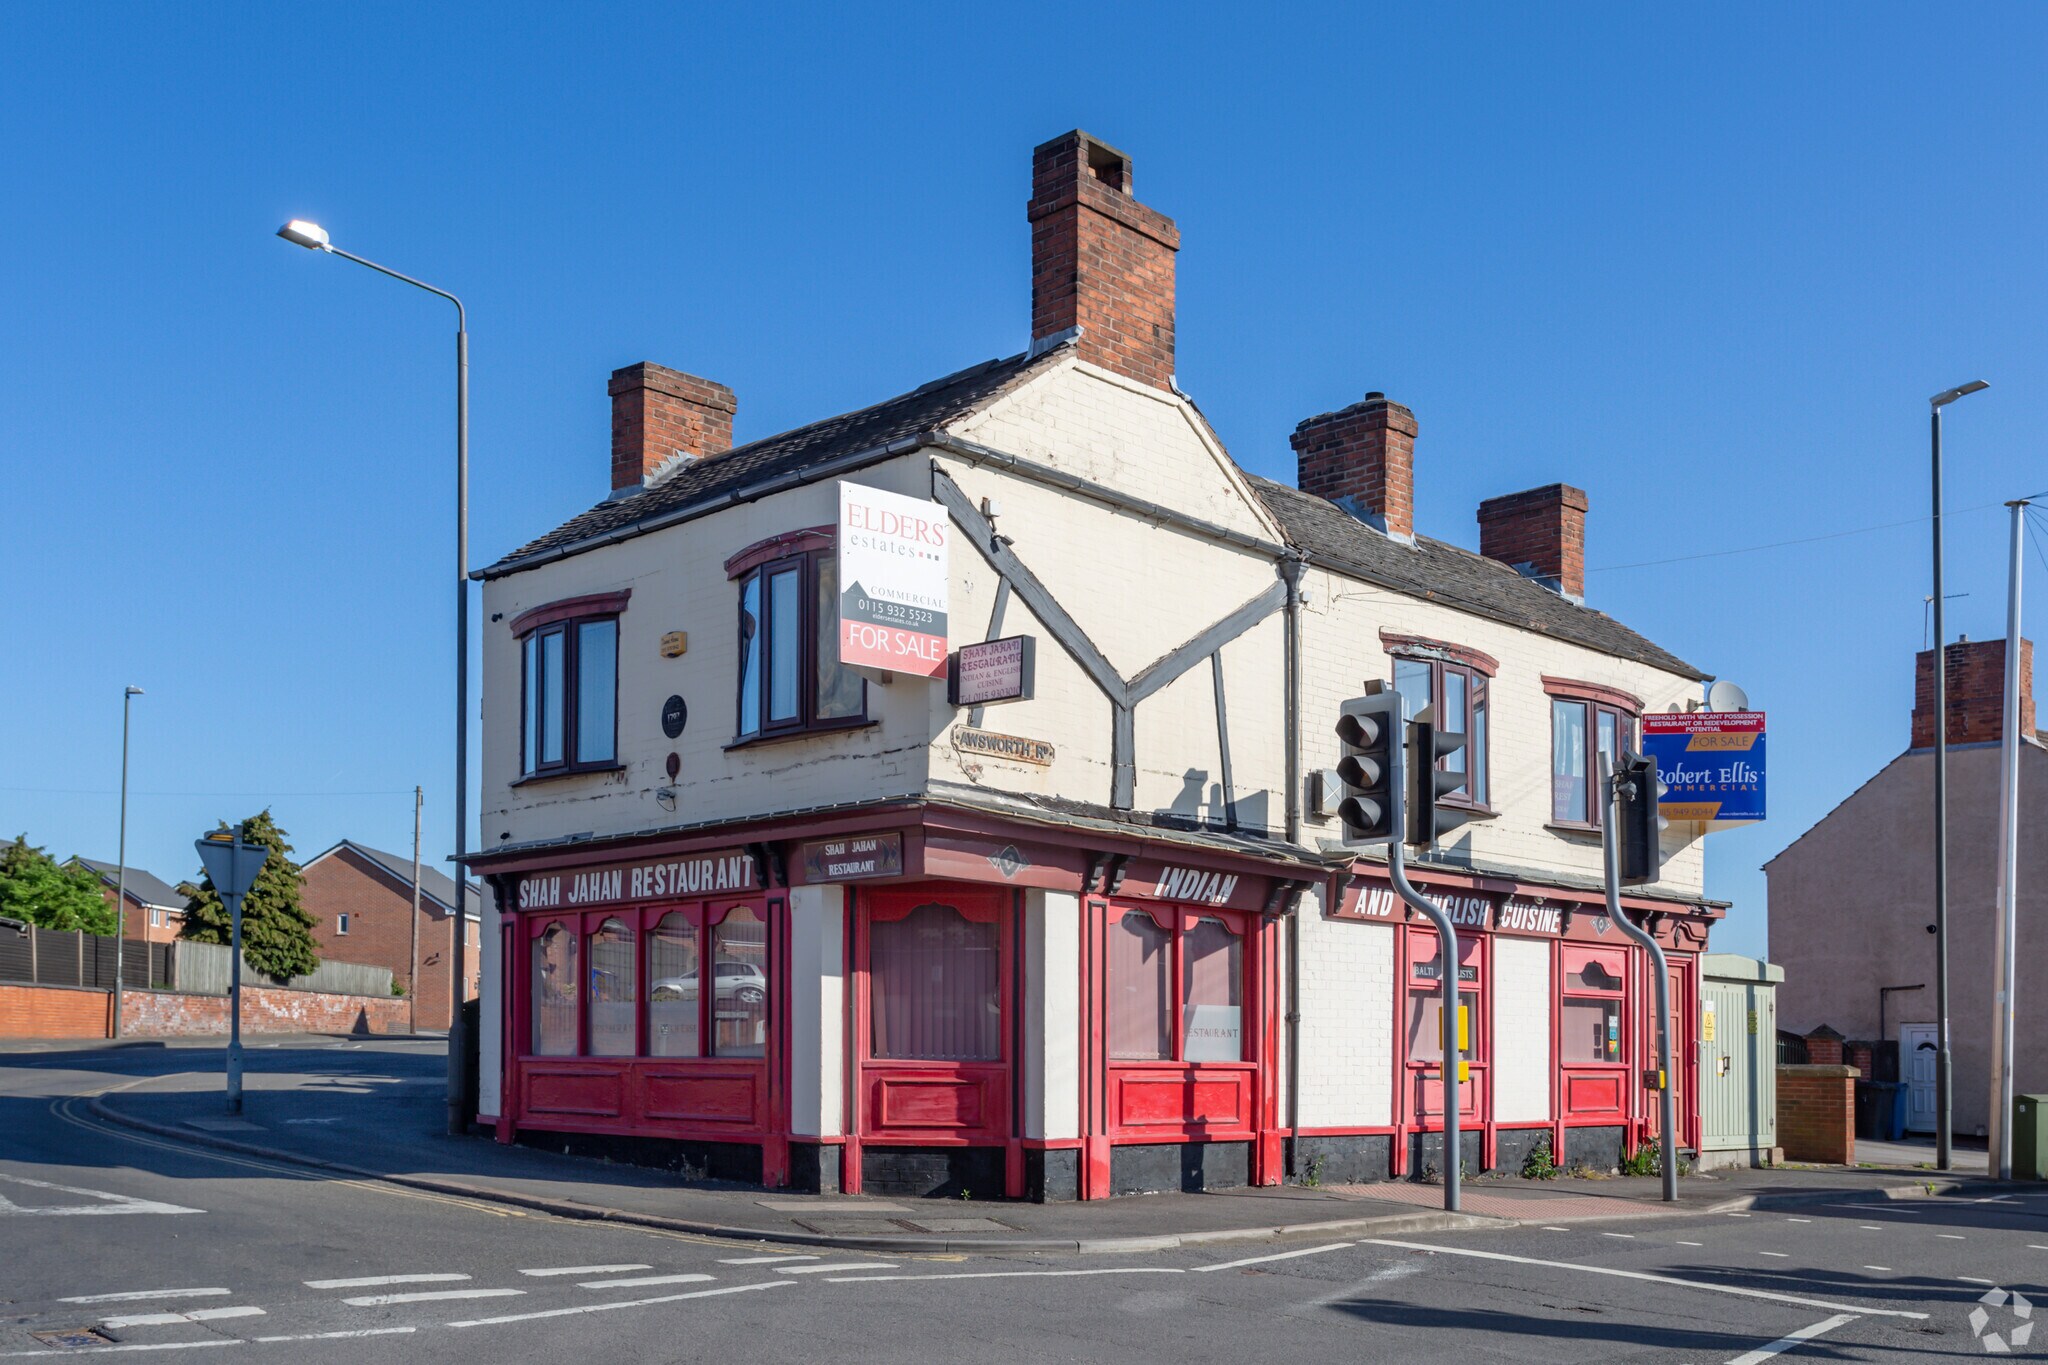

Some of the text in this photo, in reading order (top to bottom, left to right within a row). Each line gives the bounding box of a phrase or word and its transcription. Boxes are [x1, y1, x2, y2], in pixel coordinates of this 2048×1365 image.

[847, 503, 944, 547] ELDERS
[850, 534, 915, 559] estates
[870, 586, 944, 609] COMMERCIAL
[858, 598, 933, 623] 0115 932 5523
[872, 613, 919, 627] eldersestates.co.uk
[849, 623, 941, 662] FOR SALE
[963, 640, 1020, 660] SHAH JAHAN
[960, 652, 1022, 673] RESTAURANT
[960, 671, 984, 684] INDIAN
[986, 671, 992, 679] &
[977, 677, 1004, 689] CUISINE
[973, 690, 989, 702] 0115
[1724, 712, 1764, 720] POSSESSION
[960, 731, 1030, 757] AWSWORTH
[1693, 736, 1748, 747] FOR SALE
[1656, 761, 1758, 785] Robert Ellis
[825, 839, 877, 856] SHAH JAHAN
[828, 859, 876, 876] RESTAURANT
[519, 854, 754, 908] SHAH JAHAN RESTAURANT
[1153, 866, 1239, 904] INDIAN
[1354, 886, 1395, 917] AND
[1501, 904, 1562, 934] CUISINE
[1414, 966, 1435, 976] BALTI
